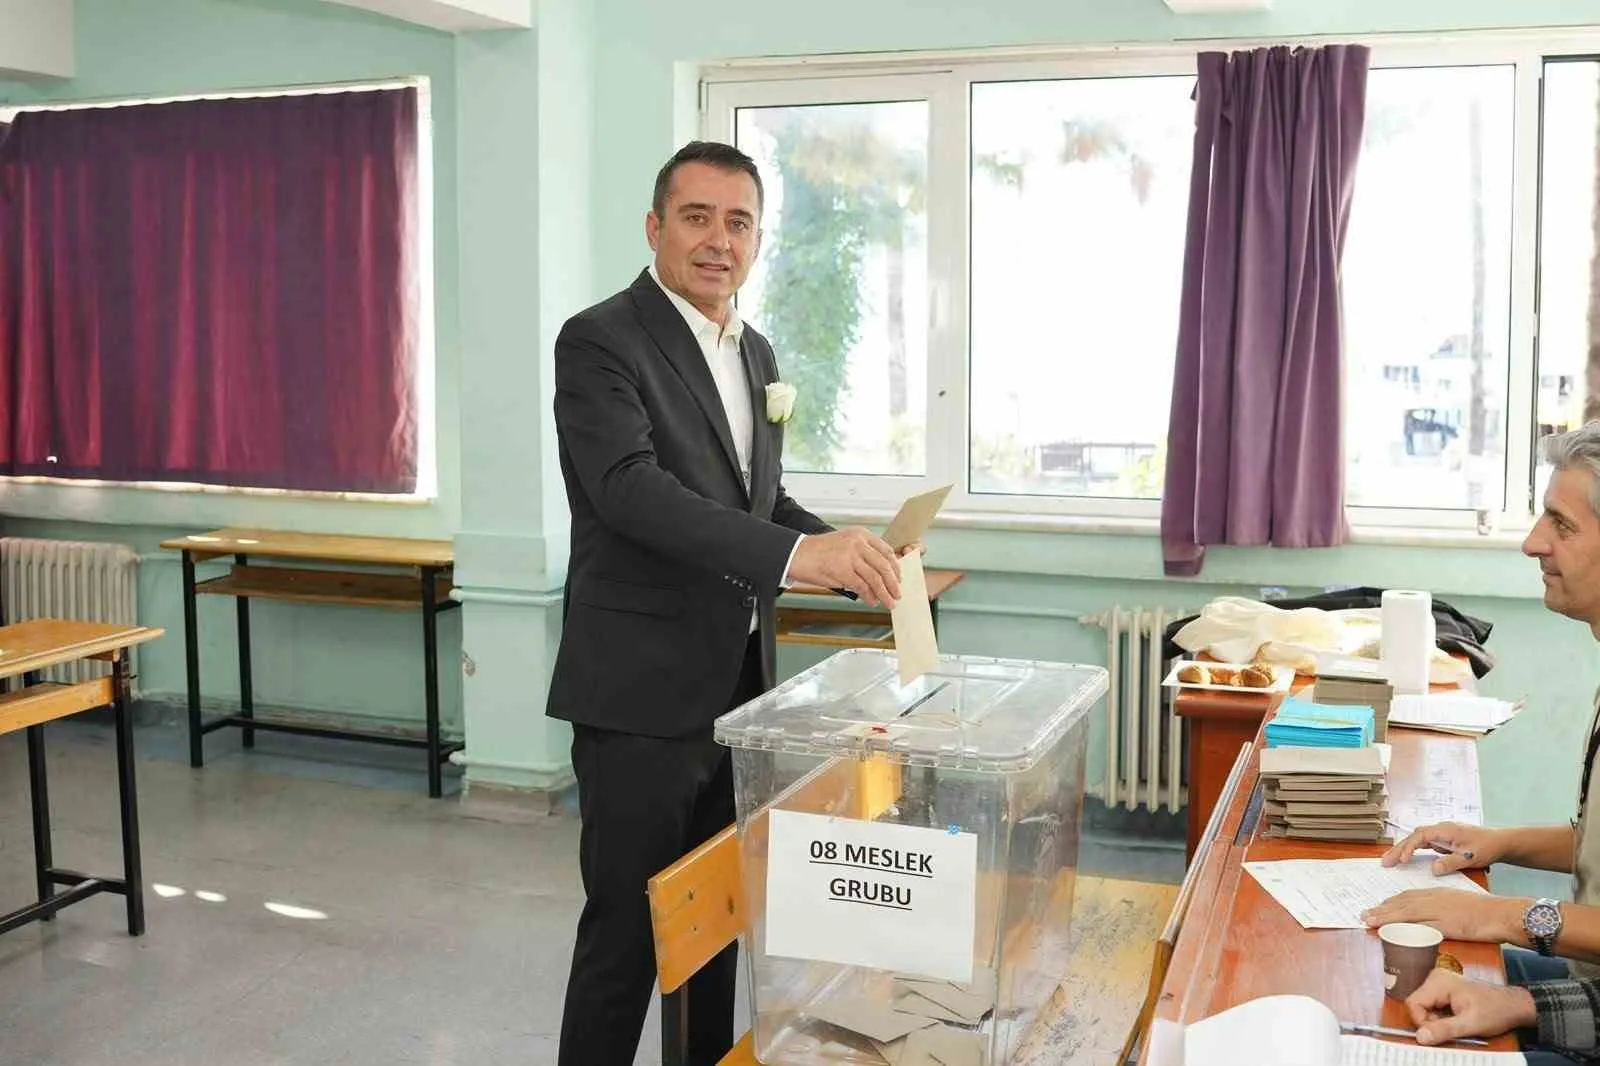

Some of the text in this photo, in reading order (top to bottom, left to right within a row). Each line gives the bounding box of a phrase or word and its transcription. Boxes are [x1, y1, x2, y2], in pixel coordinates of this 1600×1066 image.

[810, 840, 933, 873] 08 MESLEK
[830, 878, 912, 906] GRUBU
